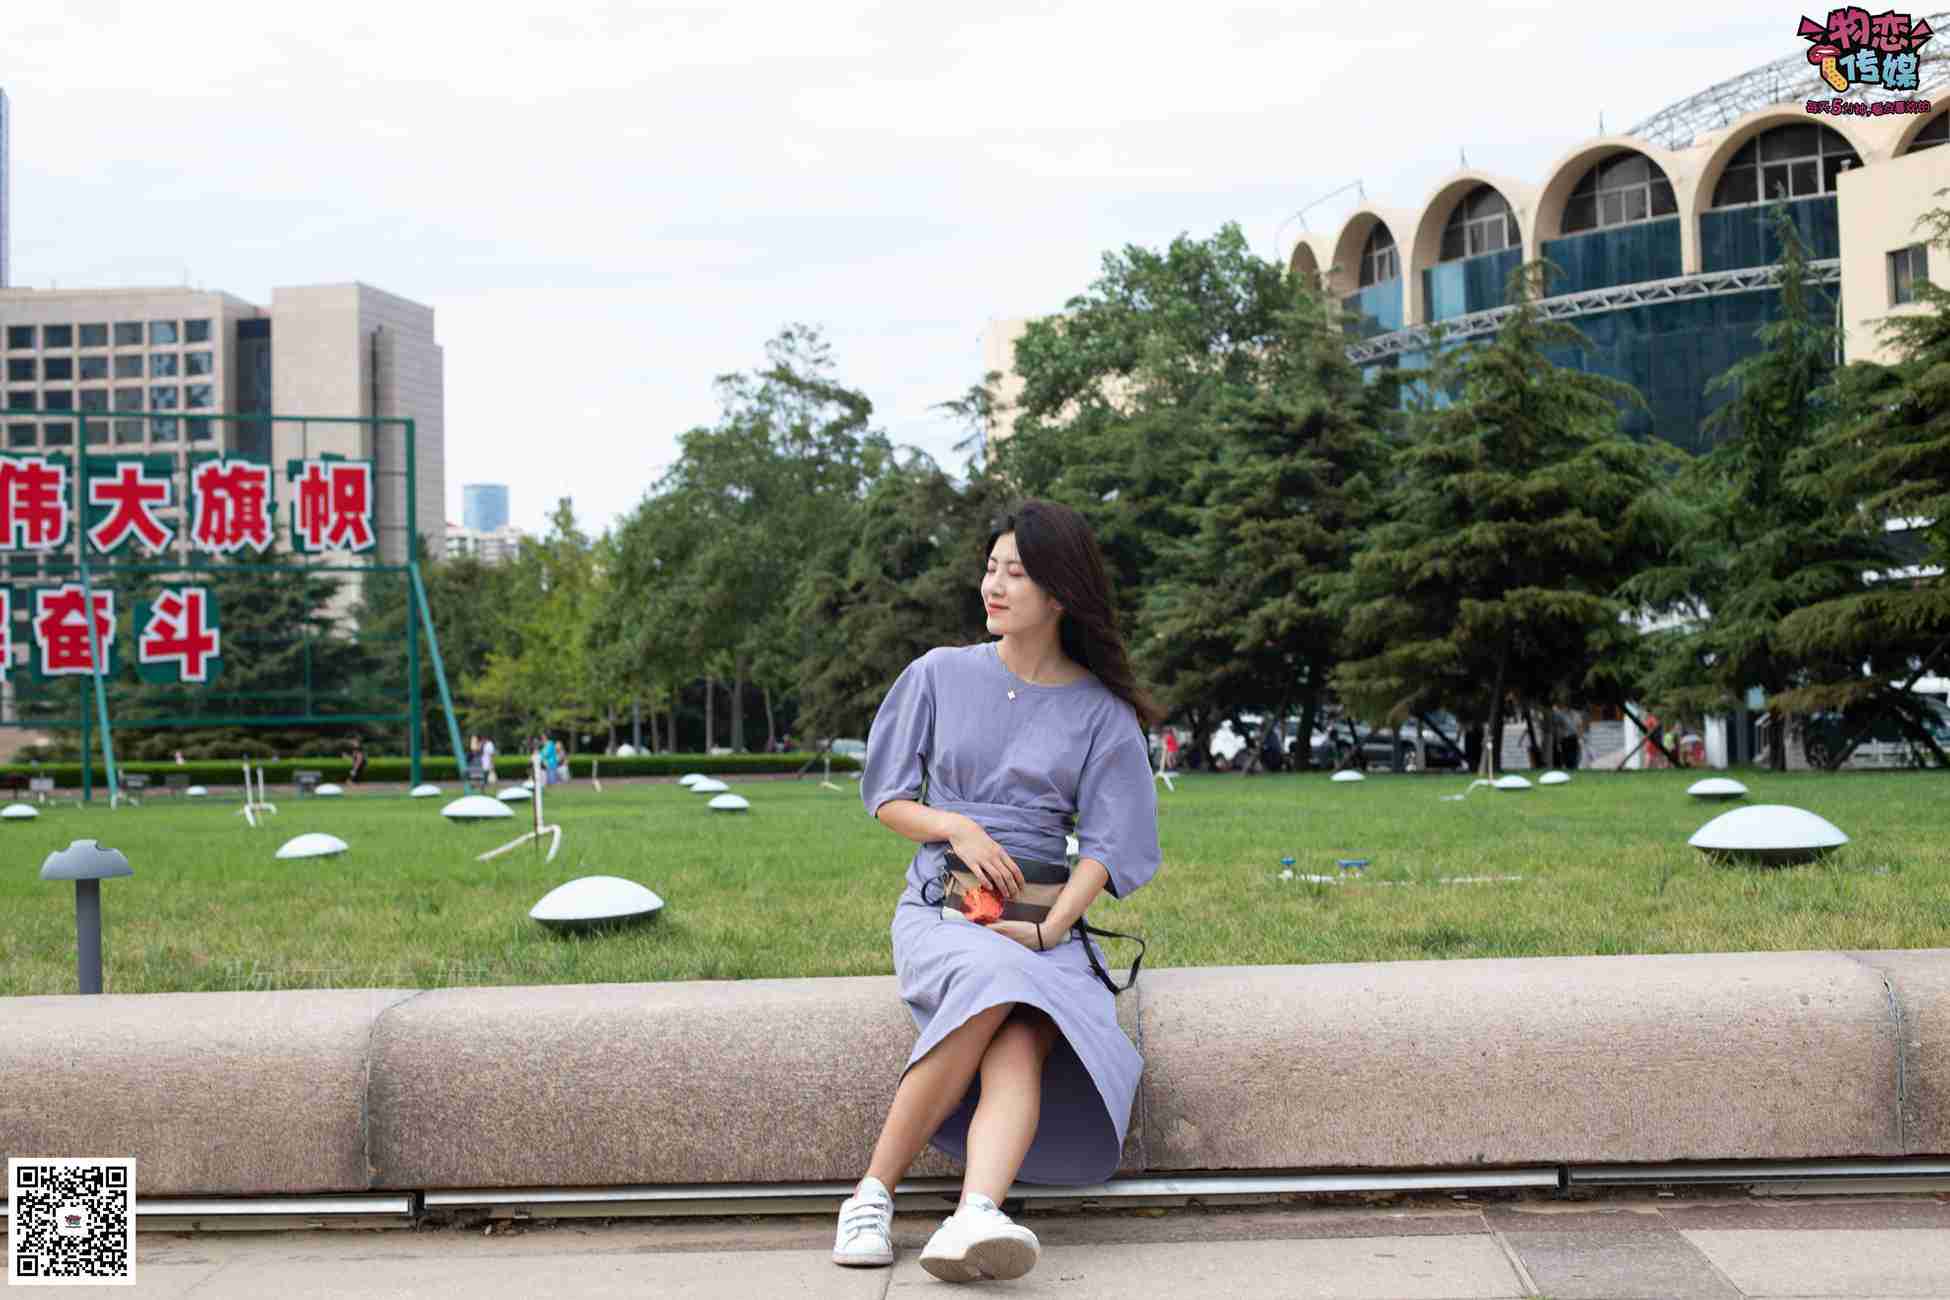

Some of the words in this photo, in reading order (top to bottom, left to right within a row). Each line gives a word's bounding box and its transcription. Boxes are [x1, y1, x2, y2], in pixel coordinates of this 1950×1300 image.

[0, 457, 375, 553] 伟大旗帜
[0, 584, 219, 682] 奋斗
